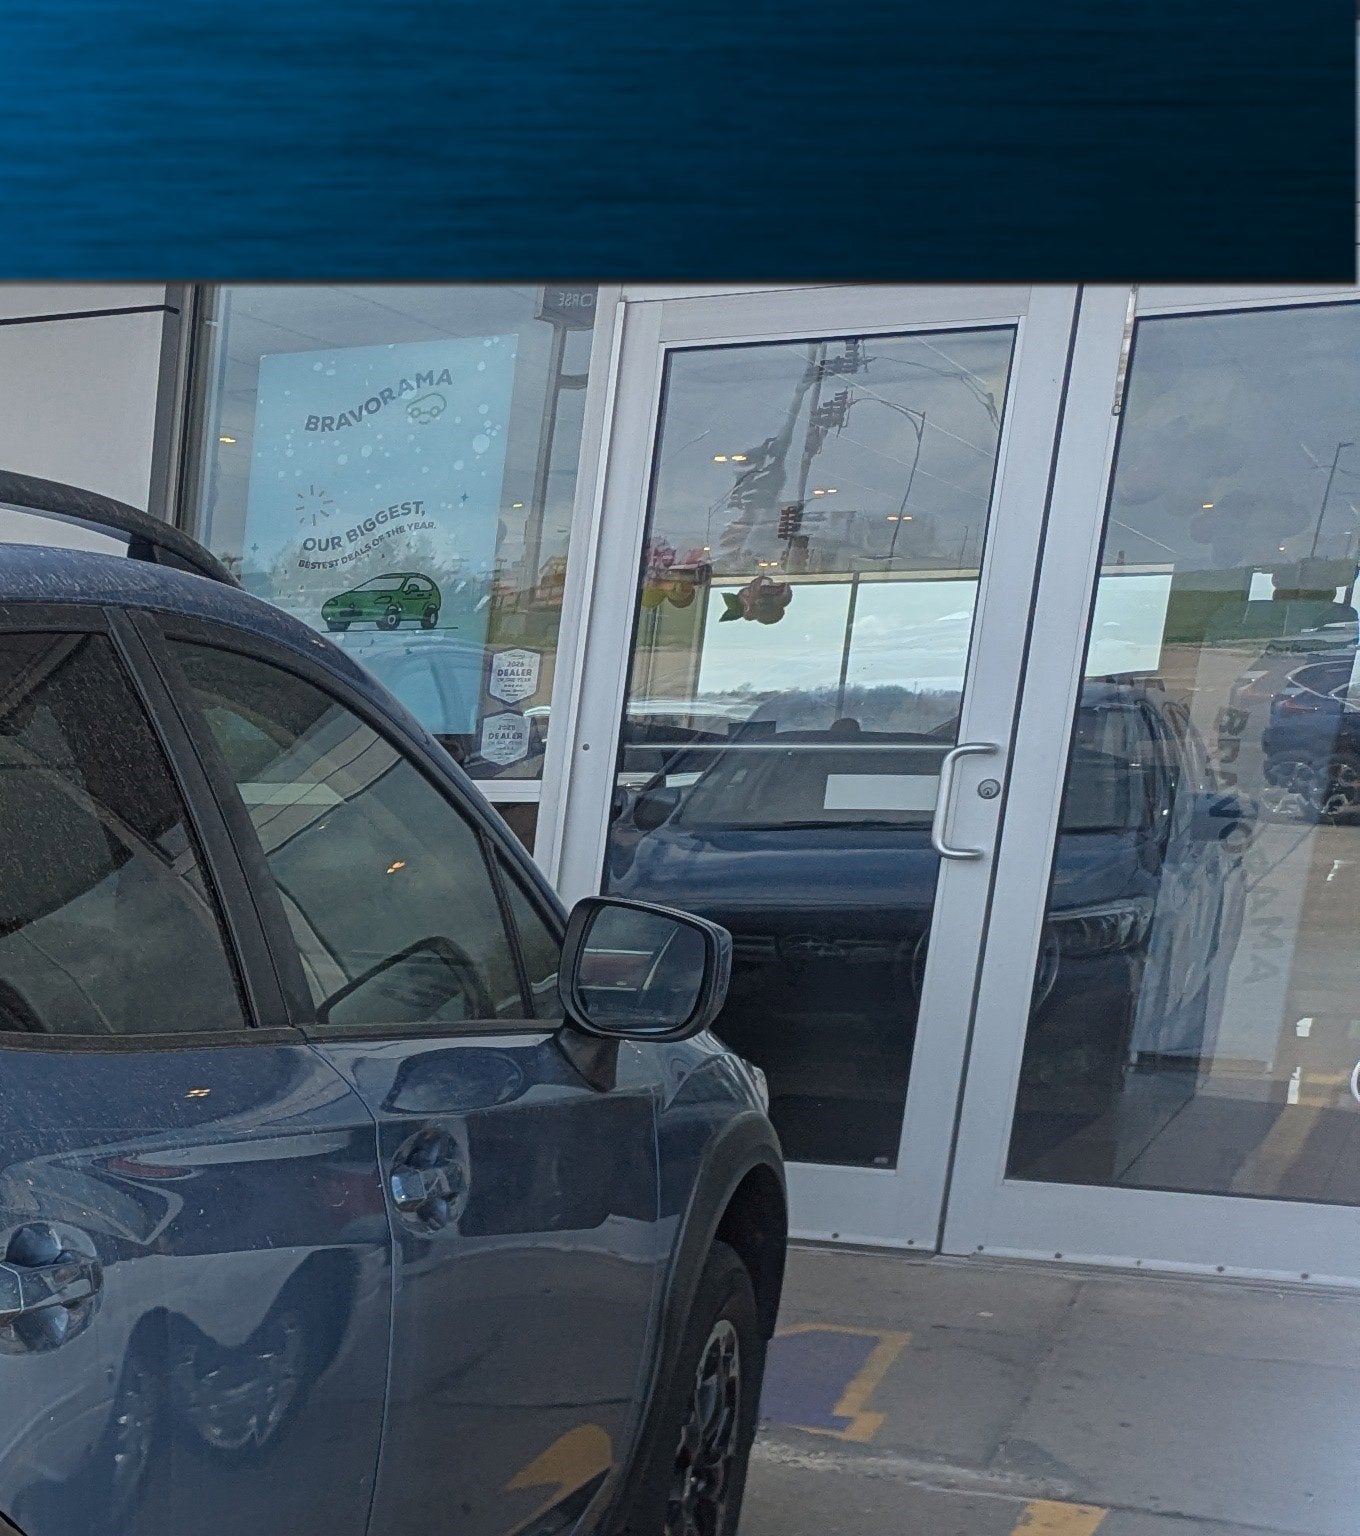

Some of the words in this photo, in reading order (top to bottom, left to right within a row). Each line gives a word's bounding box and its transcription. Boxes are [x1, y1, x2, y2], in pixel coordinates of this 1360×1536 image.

[304, 368, 453, 432] BRAVORAMA
[298, 558, 340, 570] BESTEST
[341, 542, 372, 565] DEALS
[371, 533, 385, 547] OF
[385, 524, 406, 538] THE
[302, 536, 343, 552] OUR
[345, 500, 426, 544] BIGGEST,
[497, 668, 532, 677] DEALER
[488, 731, 523, 740] DEALER
